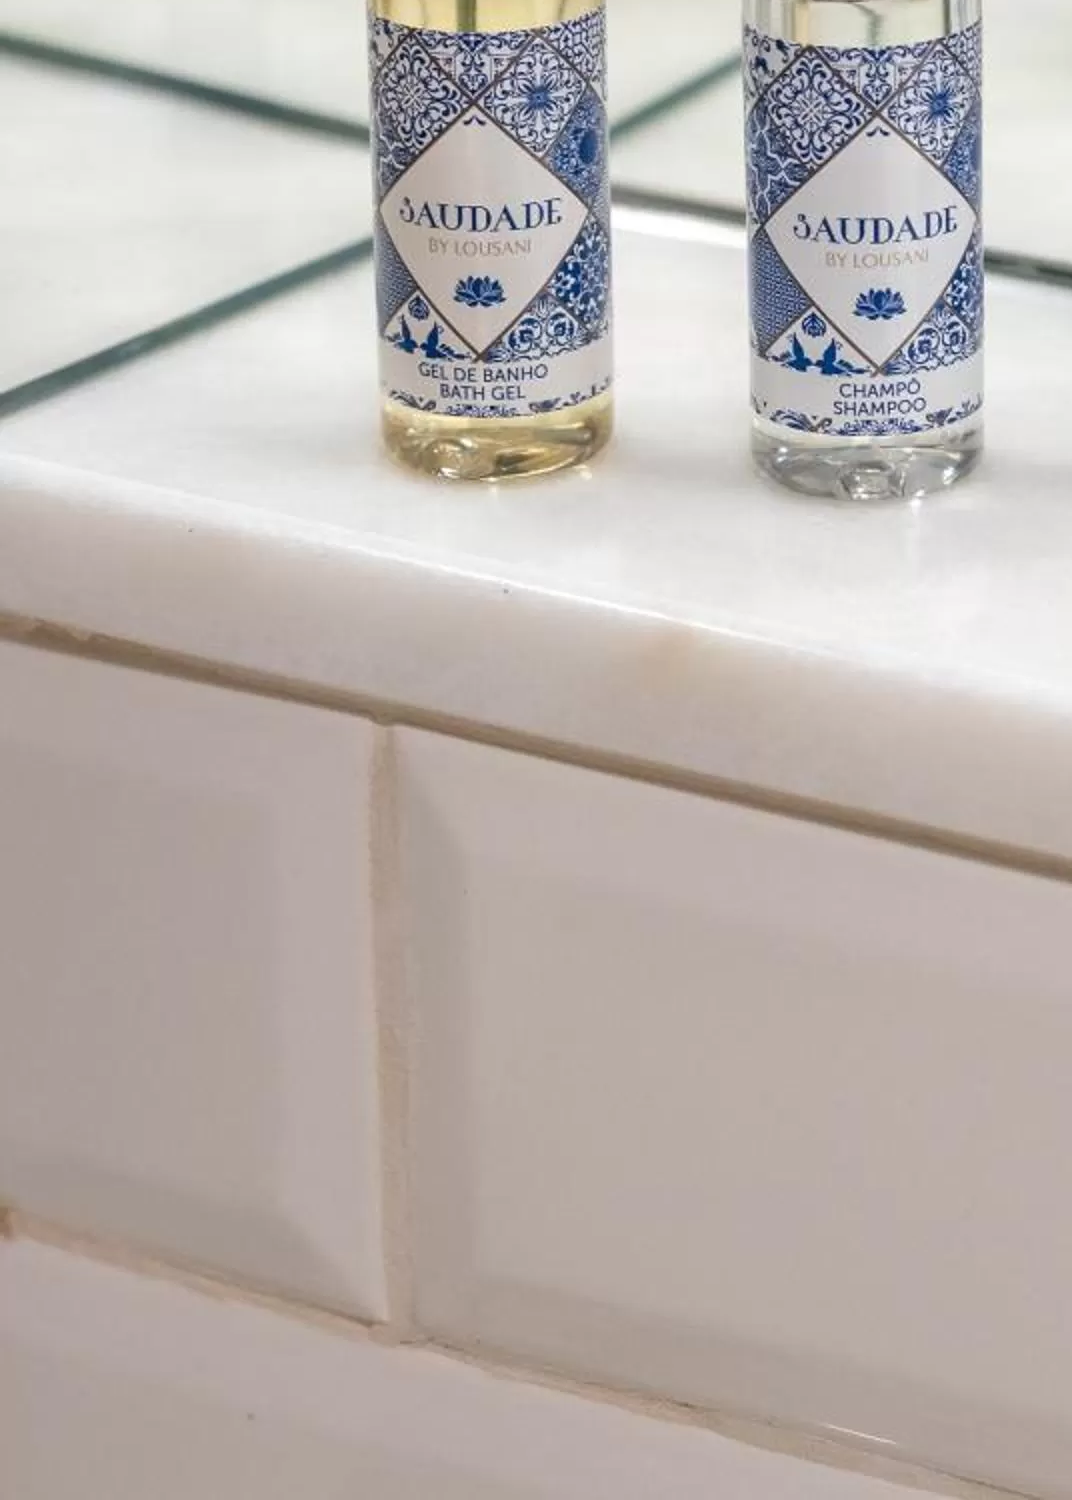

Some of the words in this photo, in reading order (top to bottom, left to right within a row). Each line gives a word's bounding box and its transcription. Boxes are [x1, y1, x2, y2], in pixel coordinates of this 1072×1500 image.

[399, 196, 562, 233] SAUDADE
[793, 205, 957, 245] SAUDADE
[428, 237, 448, 254] BY
[453, 238, 532, 257] LOUSANI
[825, 251, 846, 268] BY
[853, 248, 929, 269] LOUSANI
[418, 361, 448, 380] GEL
[454, 367, 478, 382] DE
[483, 363, 549, 382] BANHO
[439, 383, 485, 400] BATH
[491, 385, 526, 400] GEL
[833, 397, 927, 417] SHAMPOO
